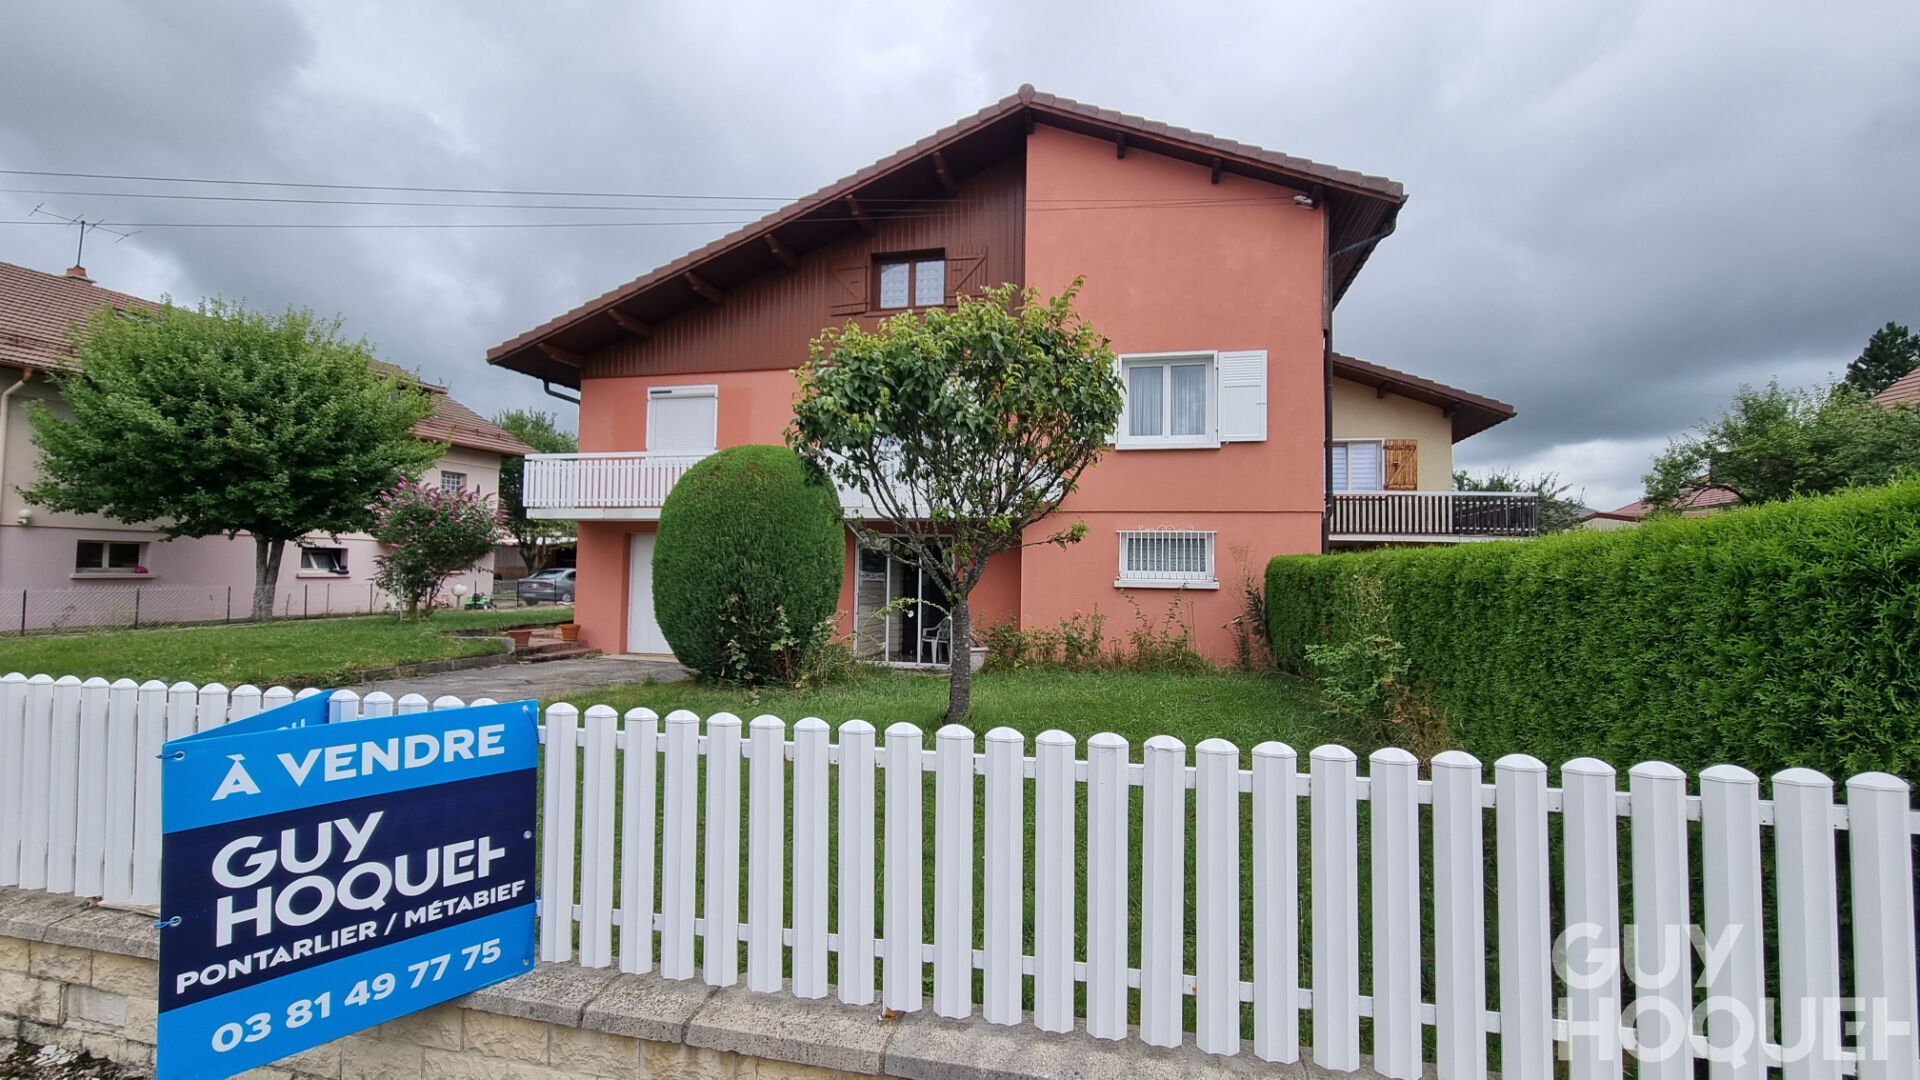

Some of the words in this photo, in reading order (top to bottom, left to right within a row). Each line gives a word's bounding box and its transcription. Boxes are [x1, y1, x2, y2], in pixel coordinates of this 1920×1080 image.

[211, 754, 261, 801] À
[277, 724, 505, 787] VENDRE
[211, 811, 384, 889] GUY
[215, 836, 506, 948] HOQUET
[176, 921, 377, 994] PONTARLIER
[384, 913, 397, 936] /
[404, 880, 525, 929] MÉTABIEF
[211, 1013, 271, 1053] 03
[285, 991, 331, 1029] 81
[344, 972, 396, 1007] 49
[408, 954, 451, 990] 77
[461, 938, 501, 972] 75
